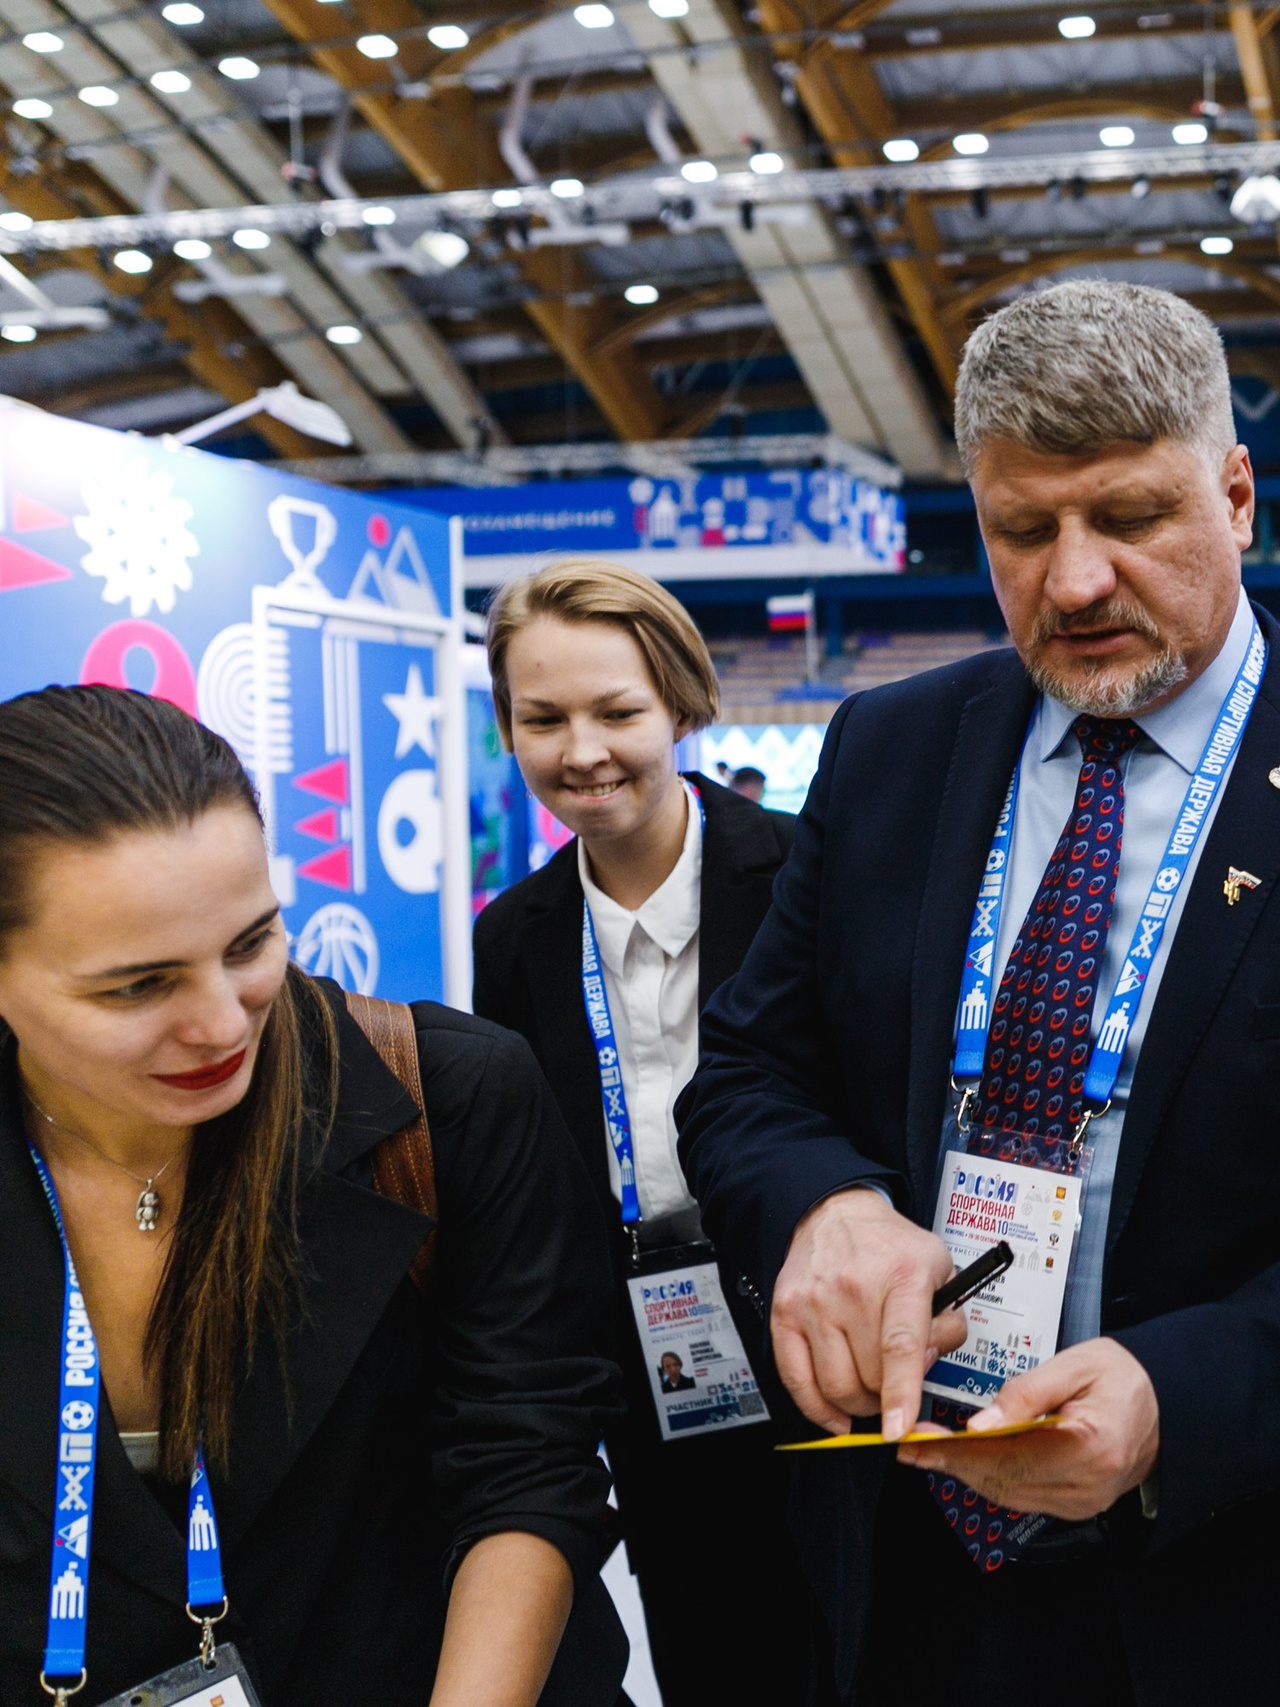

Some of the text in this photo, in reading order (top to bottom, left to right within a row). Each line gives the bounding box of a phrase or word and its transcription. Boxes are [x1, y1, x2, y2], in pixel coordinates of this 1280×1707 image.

[1200, 680, 1257, 776] СПОРТИВНАЯ
[1168, 771, 1216, 856] ДЕРЖАВА
[583, 974, 611, 1039] ДЕРЖАВА
[952, 1171, 1020, 1204] РОССИЯ
[950, 1192, 1016, 1220] СПОРТИВНАЯ
[946, 1209, 996, 1233] ДЕРЖАВА
[997, 1220, 1009, 1236] 10
[644, 1294, 699, 1315] СПОРТИВНАЯ
[647, 1308, 689, 1327] ДЕРЖАВА
[64, 1291, 97, 1387] РОССИЯ
[944, 1350, 978, 1367] ТНИК
[665, 1397, 713, 1413] УЧАСТНИК
